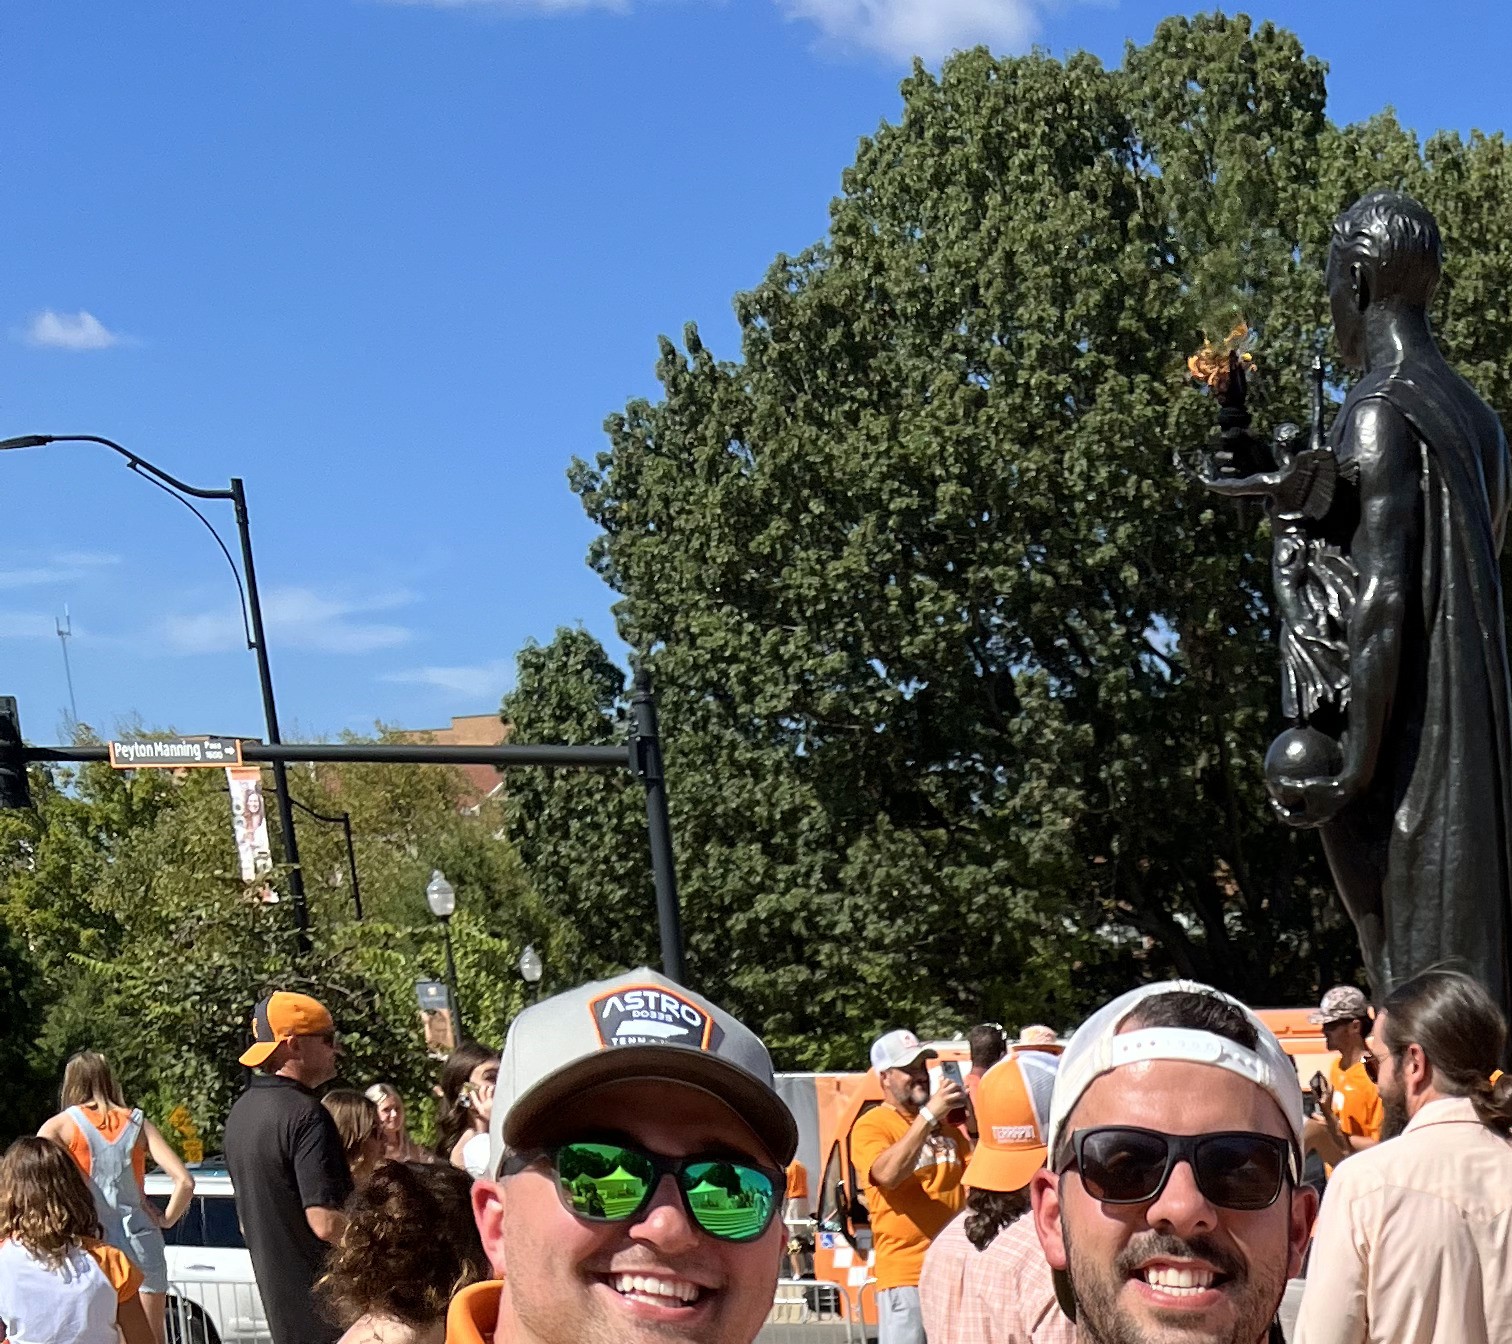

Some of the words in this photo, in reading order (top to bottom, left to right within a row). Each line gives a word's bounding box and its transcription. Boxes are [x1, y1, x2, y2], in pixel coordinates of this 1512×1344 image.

[114, 741, 154, 761] Peyton
[153, 740, 201, 761] Manning
[602, 990, 701, 1027] ASTRO
